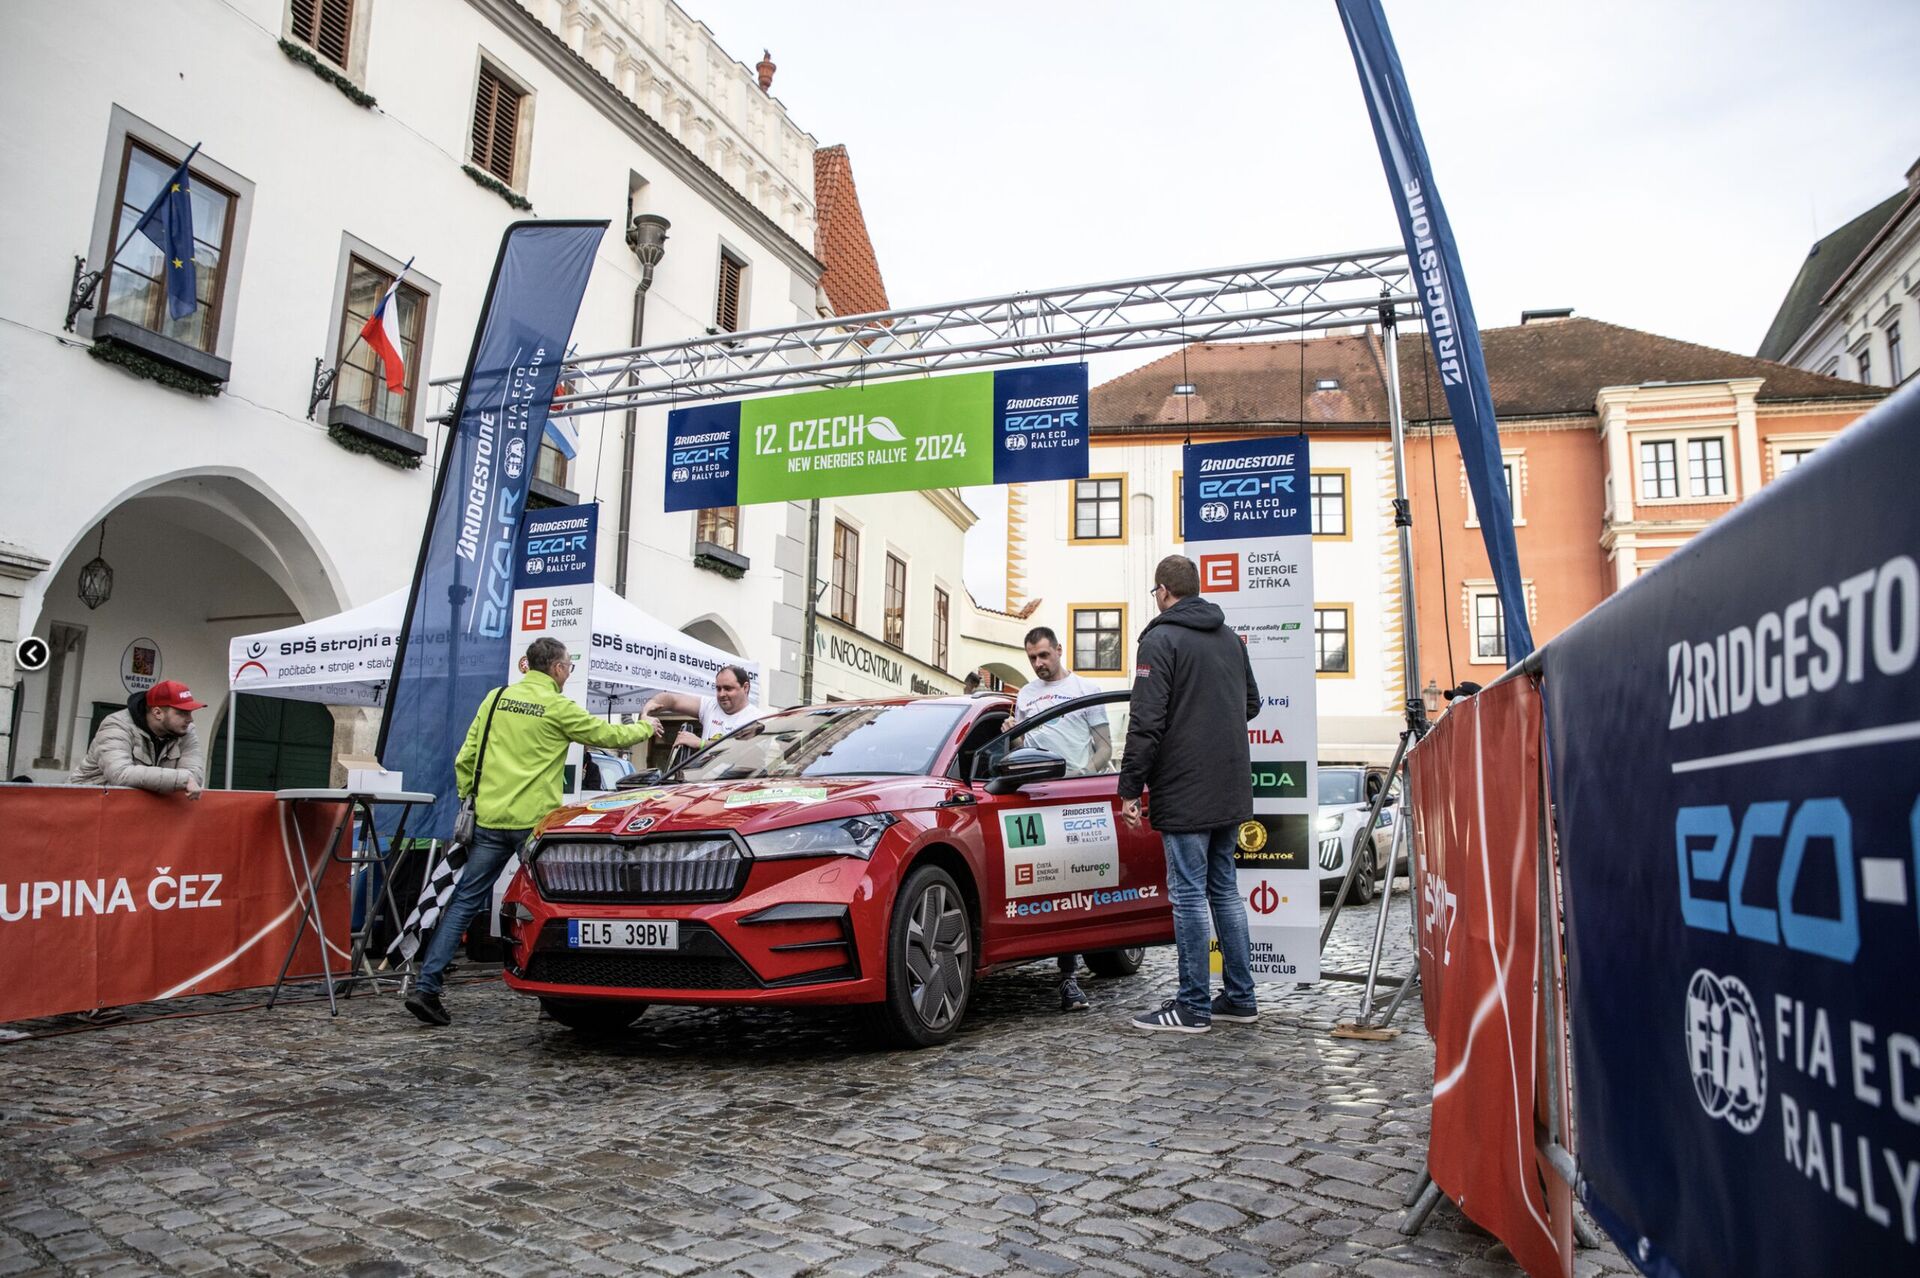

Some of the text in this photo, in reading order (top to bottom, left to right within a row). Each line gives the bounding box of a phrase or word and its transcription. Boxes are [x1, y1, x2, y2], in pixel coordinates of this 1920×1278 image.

[1405, 177, 1463, 386] BRIDGESTONE
[508, 367, 525, 429] FIA ECO
[520, 348, 545, 430] RALLY CUP
[1006, 395, 1079, 410] BRIDGESTONE
[673, 431, 731, 446] BRIDGESTONE
[755, 414, 864, 455] 12. CZECH
[915, 433, 967, 461] 2024
[1031, 439, 1080, 449] RALLY CUP
[788, 448, 907, 472] NEW ENERGIES RALLYE
[1200, 453, 1295, 472] BRIDGESTONE
[456, 411, 495, 562] BRIDGESTONE
[1233, 498, 1279, 510] FIA ECO
[1233, 508, 1297, 520] RALLY CUP
[528, 518, 589, 534] BRIDGESTONE
[547, 554, 576, 564] FIA ECO
[1248, 550, 1281, 563] ČISTÁ
[546, 562, 586, 573] RALLY CUP
[1248, 564, 1298, 576] ENERGIE
[1249, 577, 1291, 589] ZÍTŘKA
[552, 597, 573, 607] ČISTÁ
[551, 608, 583, 617] ENERGIE
[280, 636, 317, 656] SPŠ
[320, 633, 377, 652] strojní
[382, 636, 391, 647] a
[592, 632, 623, 651] SPŠ
[625, 642, 668, 660] strojní
[670, 652, 677, 661] a
[831, 635, 903, 686] INFOCENTRUM
[278, 662, 316, 679] počítače
[328, 661, 355, 673] stroje
[590, 659, 623, 673] počítače
[631, 664, 652, 678] stroje
[660, 670, 681, 684] stavby
[688, 675, 704, 688] teplo
[1268, 696, 1289, 707] kraj
[508, 706, 545, 717] CONTACT
[1062, 807, 1104, 816] BRIDGESTONE
[1015, 815, 1038, 846] 14
[1071, 862, 1110, 876] futurego
[0, 866, 223, 922] UPINA ČEZ
[1006, 885, 1159, 918] #ecorallyteamcz
[582, 923, 668, 946] EL5 39BV
[1271, 965, 1296, 974] CLUB
[1775, 993, 1836, 1088] FIA
[1780, 1092, 1920, 1245] RALLY
